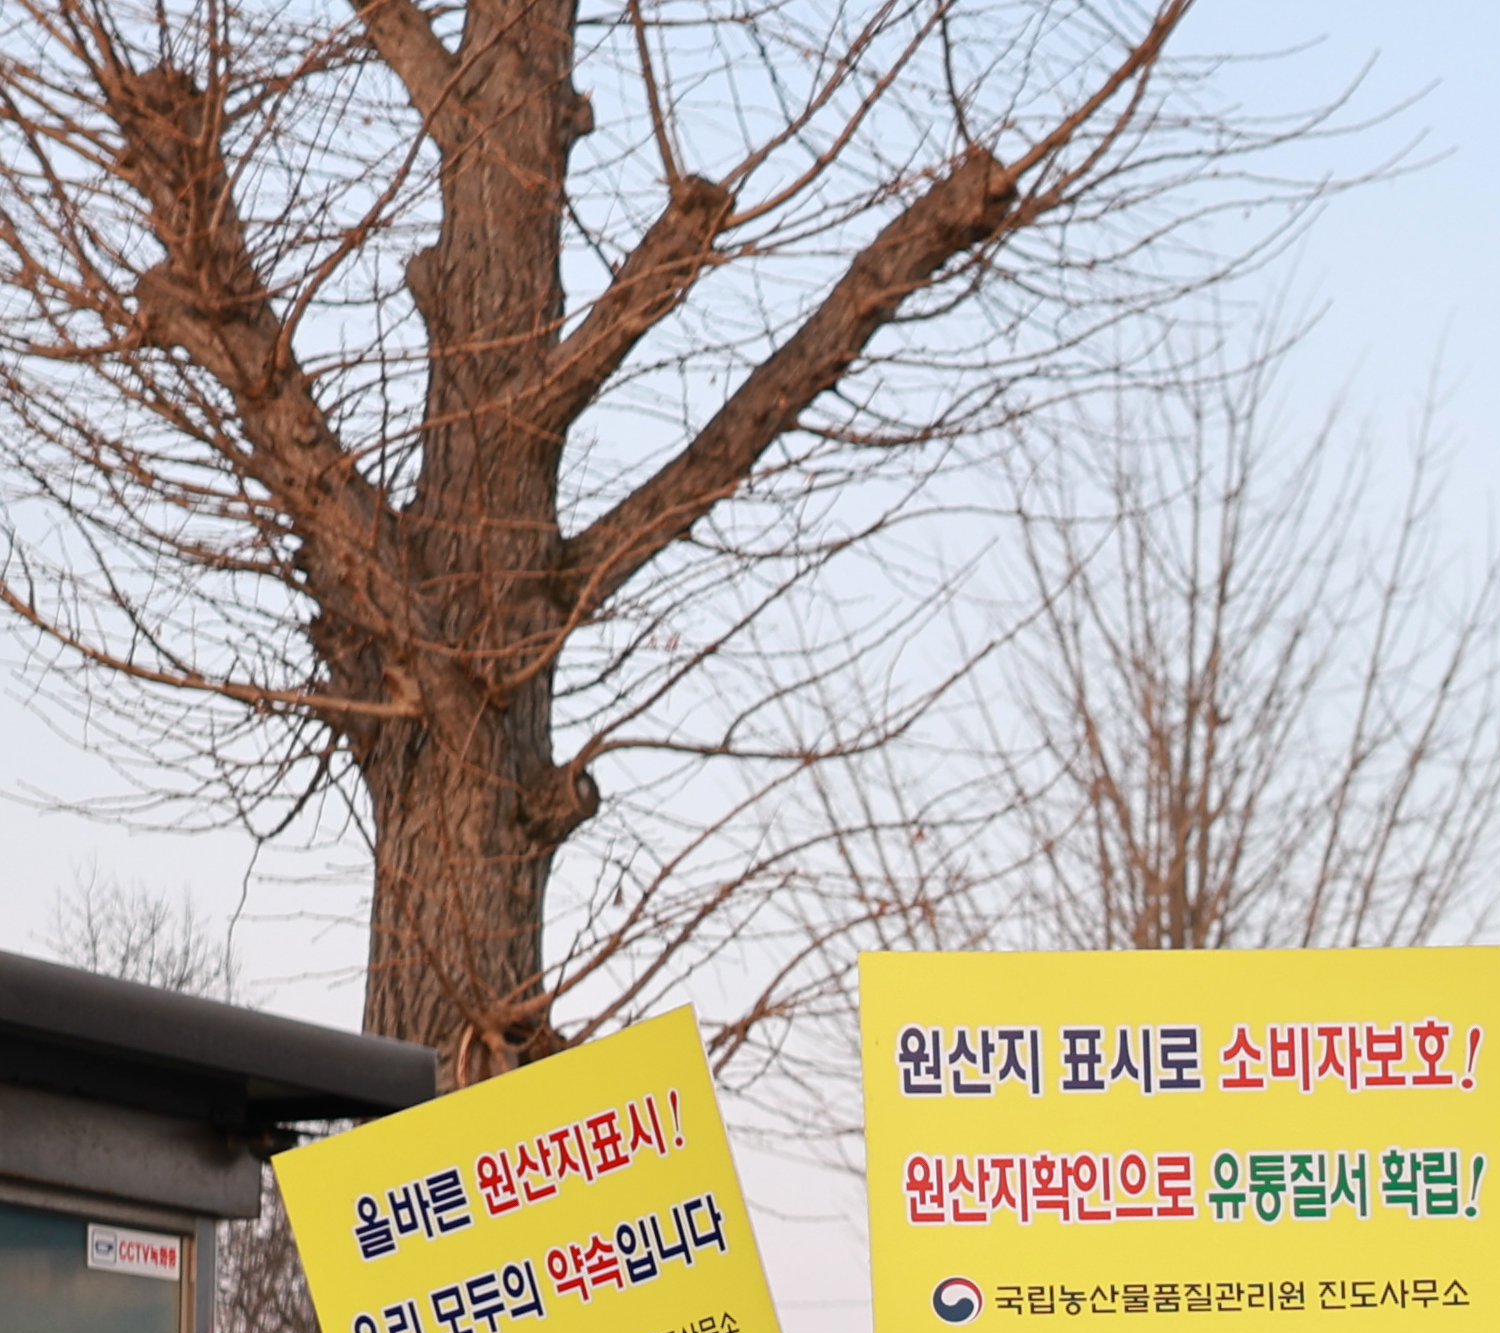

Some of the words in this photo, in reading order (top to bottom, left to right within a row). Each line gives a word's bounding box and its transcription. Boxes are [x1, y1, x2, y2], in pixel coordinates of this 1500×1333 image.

[897, 1026, 1043, 1097] 원산지
[1060, 1025, 1202, 1093] 표시로
[1220, 1018, 1482, 1091] 소비자보호!
[353, 1167, 471, 1260] 올바른
[476, 1088, 686, 1216] 원산지표시!
[905, 1153, 1194, 1225] 원산지확인으로
[1208, 1152, 1368, 1221] 유통질서
[1380, 1147, 1484, 1218] 확립!
[547, 1193, 726, 1302] 약속입니다
[993, 1280, 1306, 1316] 국립농산물품질관리원
[1319, 1277, 1470, 1311] 진도사무소
